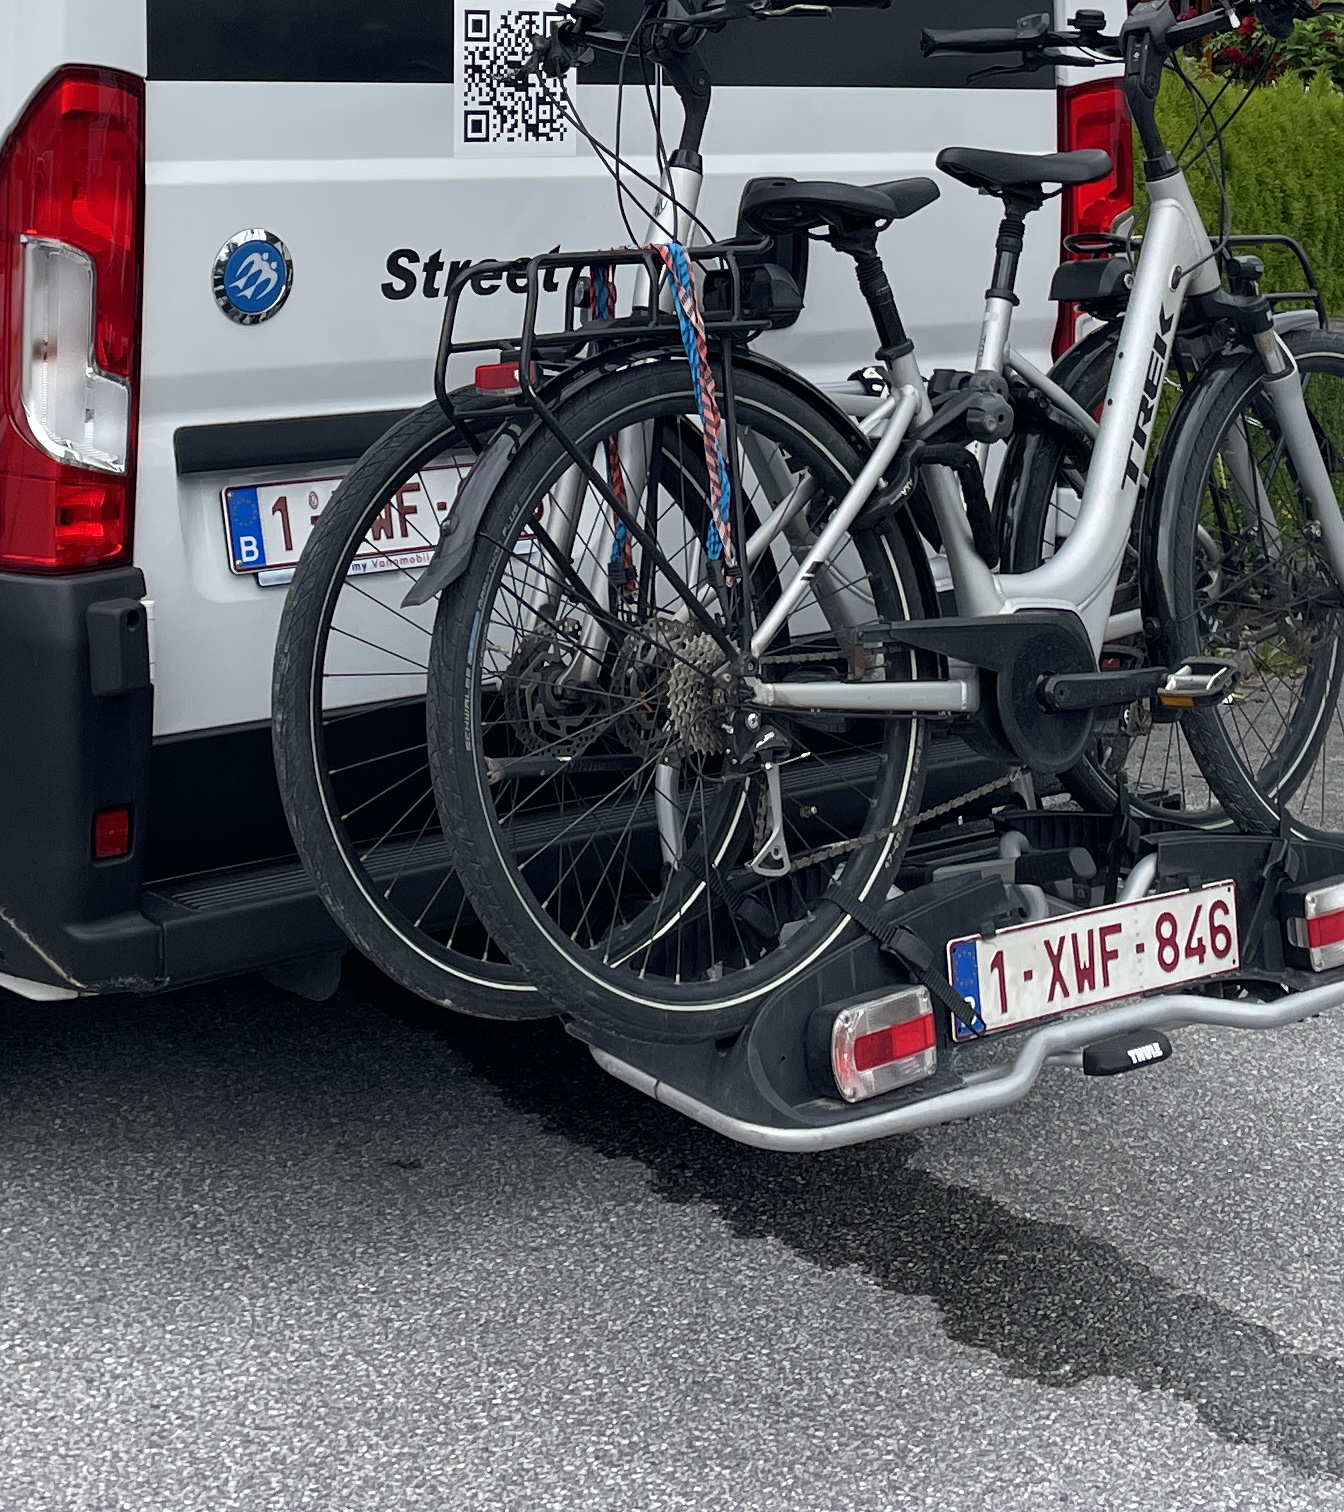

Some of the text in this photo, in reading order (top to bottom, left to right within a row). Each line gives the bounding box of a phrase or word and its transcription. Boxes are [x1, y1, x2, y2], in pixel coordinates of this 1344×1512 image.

[1121, 300, 1174, 490] TREK
[239, 536, 259, 563] B
[351, 563, 367, 572] my
[989, 899, 1233, 1015] 1-XWF-846
[1126, 1042, 1164, 1064] THULE
